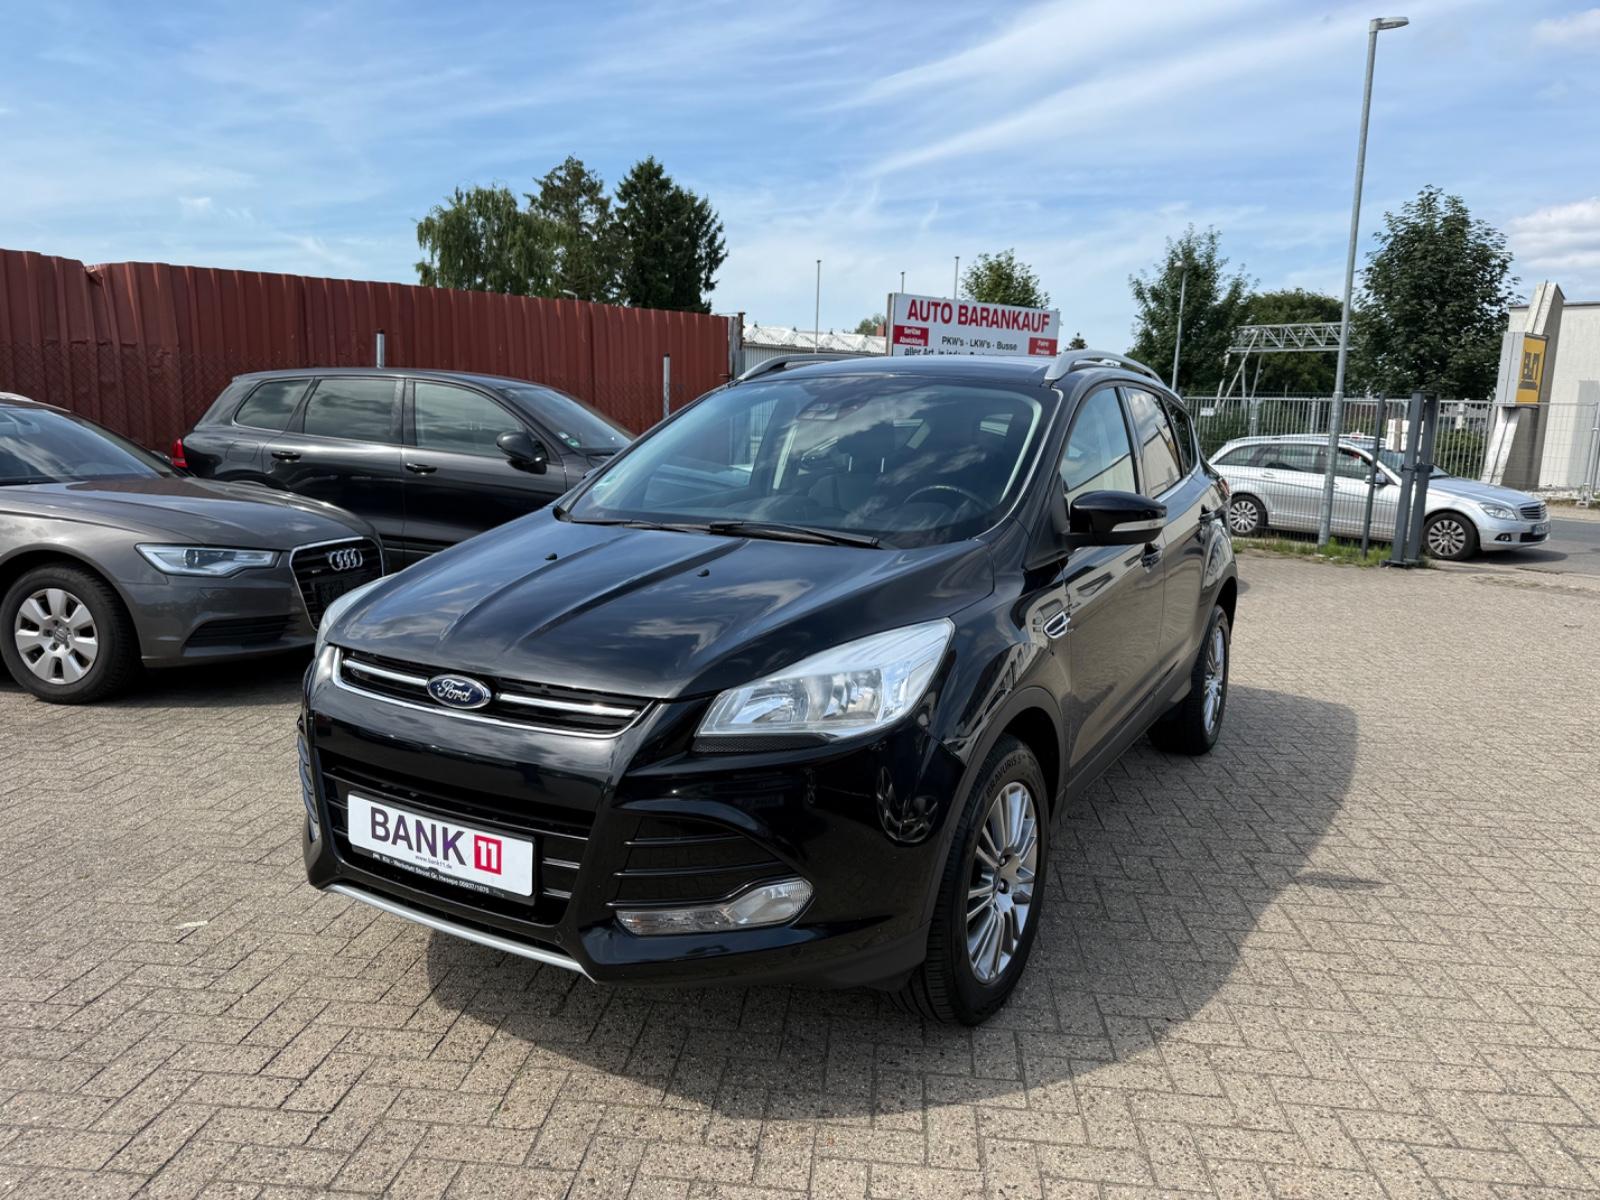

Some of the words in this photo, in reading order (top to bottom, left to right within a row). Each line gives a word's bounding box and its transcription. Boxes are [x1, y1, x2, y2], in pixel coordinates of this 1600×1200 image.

[907, 299, 953, 324] AUTO
[957, 304, 1050, 333] BARANKAUF
[941, 336, 965, 348] PKW's
[969, 338, 991, 349] LKW's
[996, 341, 1018, 351] Busse
[437, 679, 474, 702] Ford
[371, 806, 467, 866] BANK
[476, 838, 499, 872] 11
